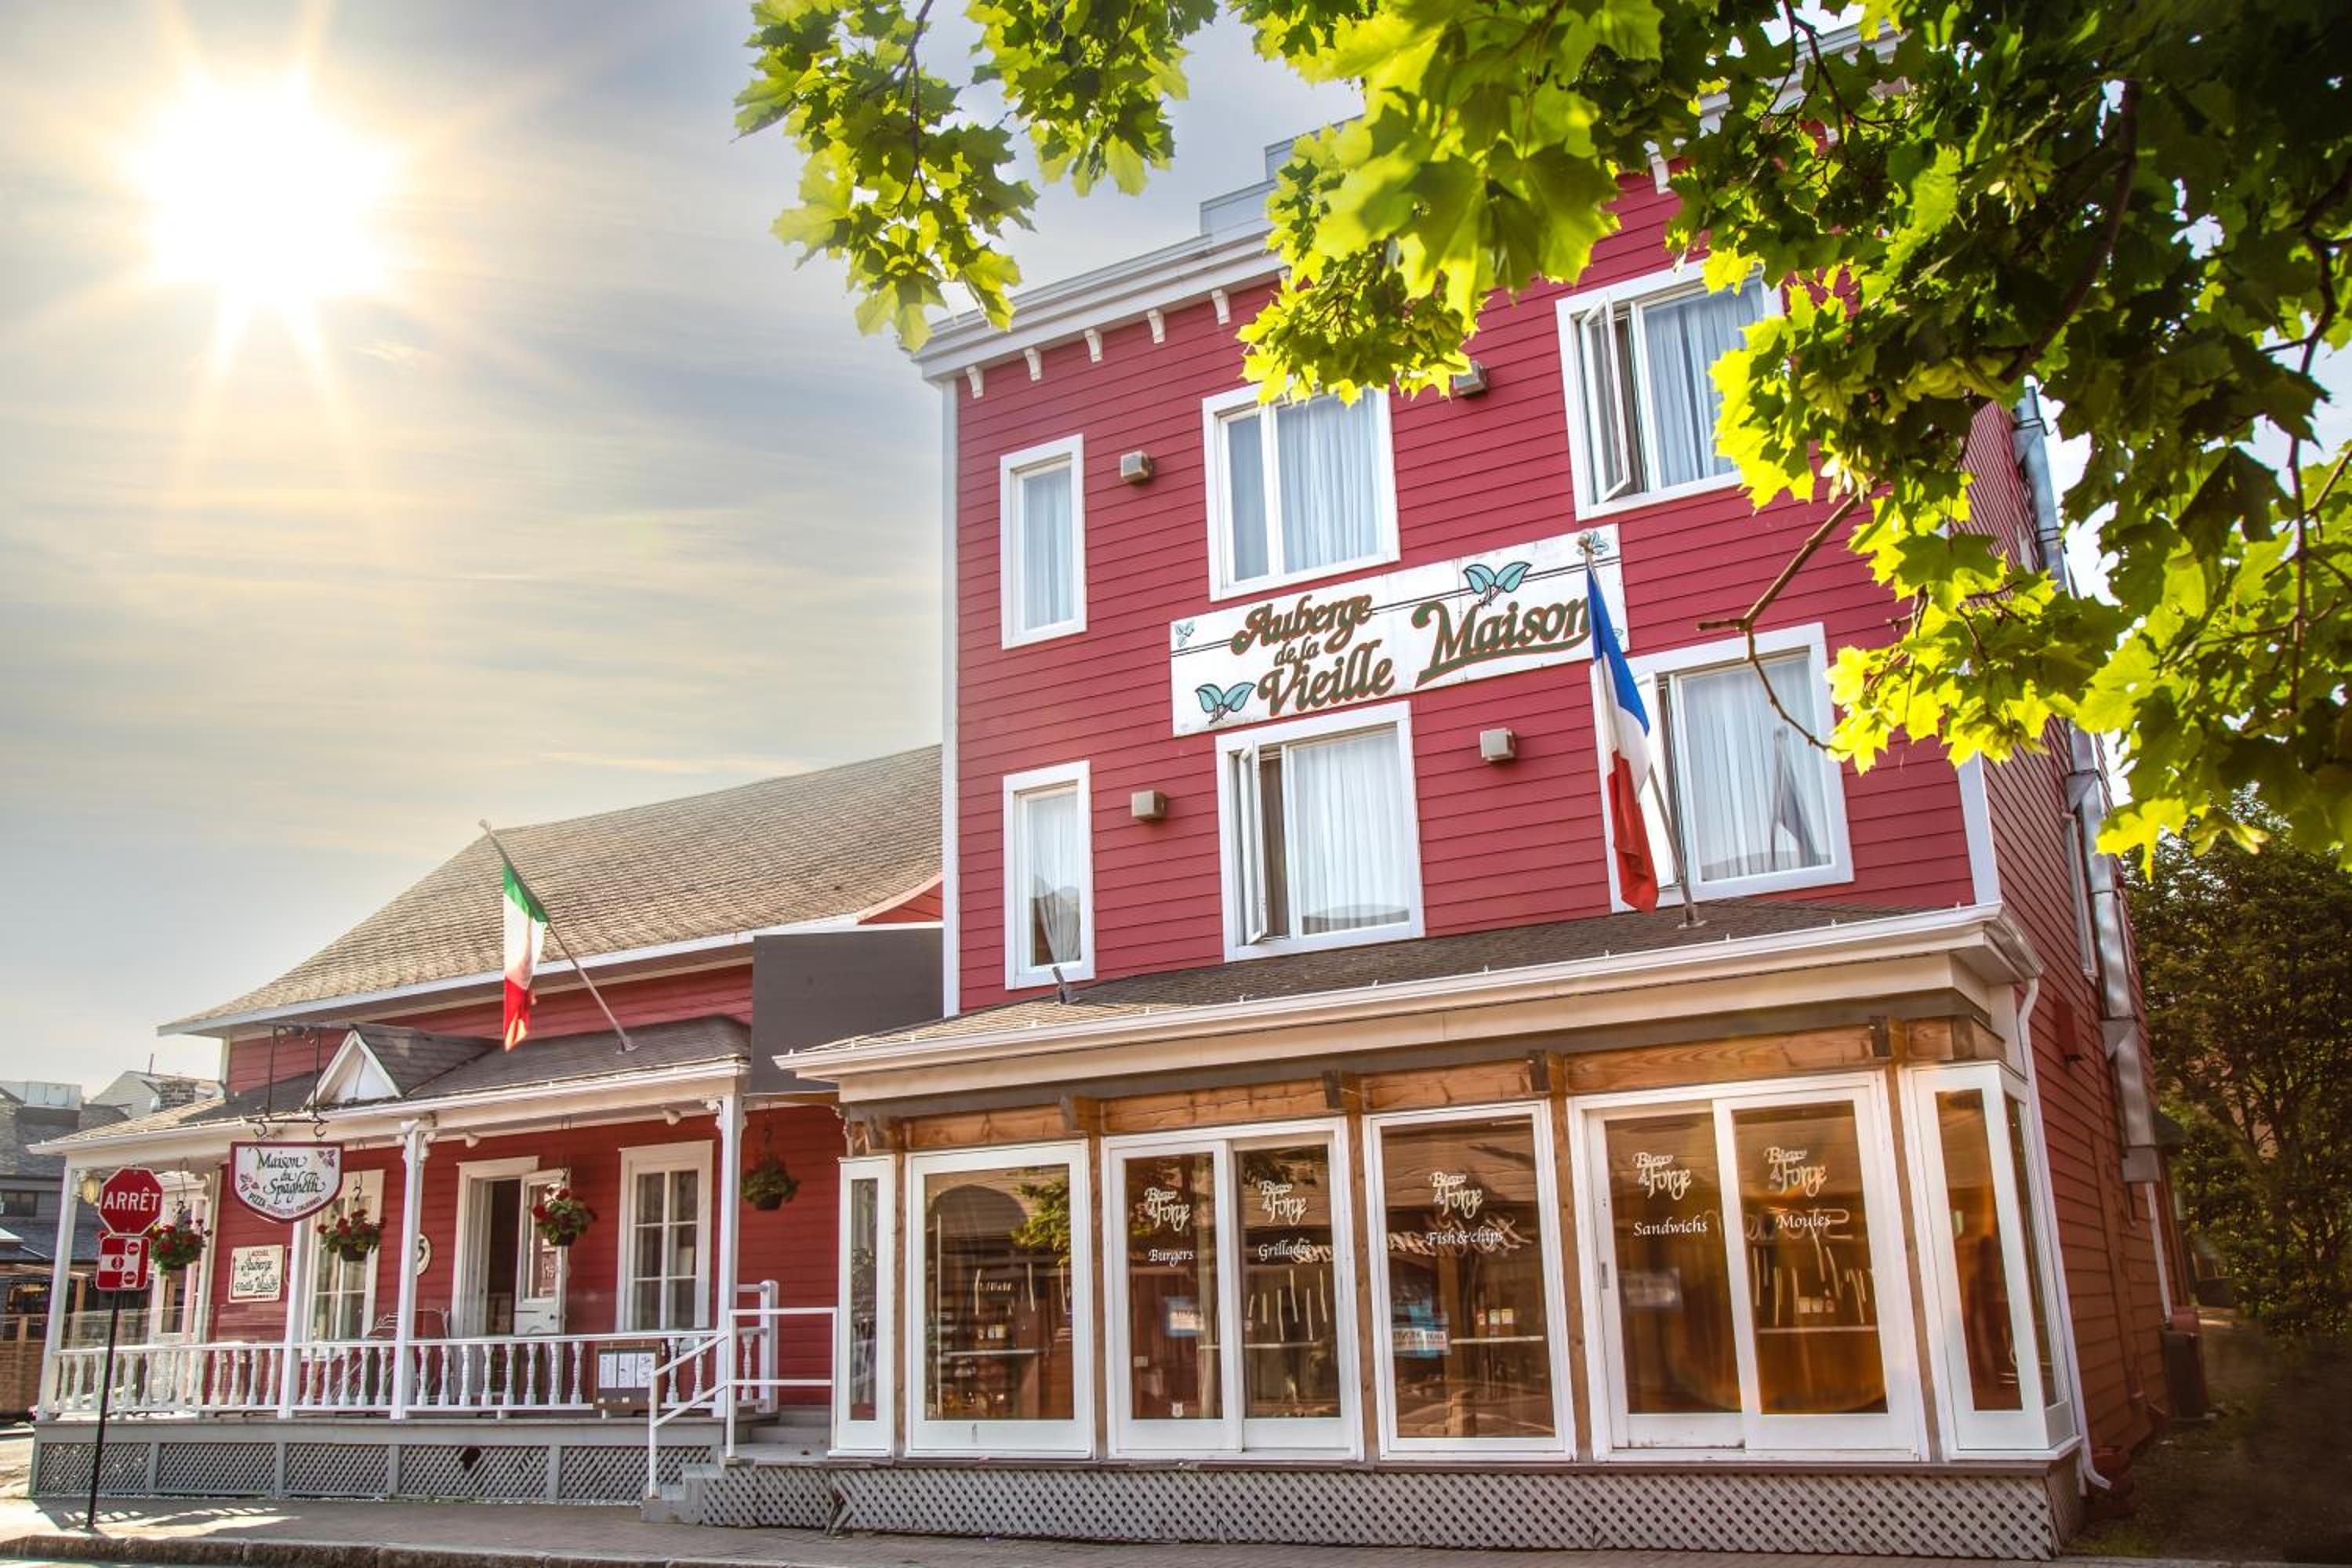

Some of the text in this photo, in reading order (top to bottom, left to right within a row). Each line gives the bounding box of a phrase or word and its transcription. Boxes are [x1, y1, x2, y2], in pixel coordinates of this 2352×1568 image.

[1231, 593, 1373, 655] Auberge
[1411, 596, 1591, 666] Maison
[1274, 636, 1321, 666] de la
[1257, 639, 1395, 717] Vieille
[255, 1147, 308, 1170] Maison
[1647, 1165, 1692, 1200] Forge
[1780, 1160, 1828, 1197] Forge
[103, 1186, 160, 1211] ARRÊT
[1154, 1197, 1191, 1232] Forge
[1269, 1191, 1307, 1226] Forge
[1443, 1184, 1483, 1219] Forge
[1633, 1214, 1708, 1236] Sandwichs
[1776, 1209, 1831, 1229] Moules
[1427, 1227, 1457, 1247] Fish
[1147, 1249, 1193, 1268] Burgers
